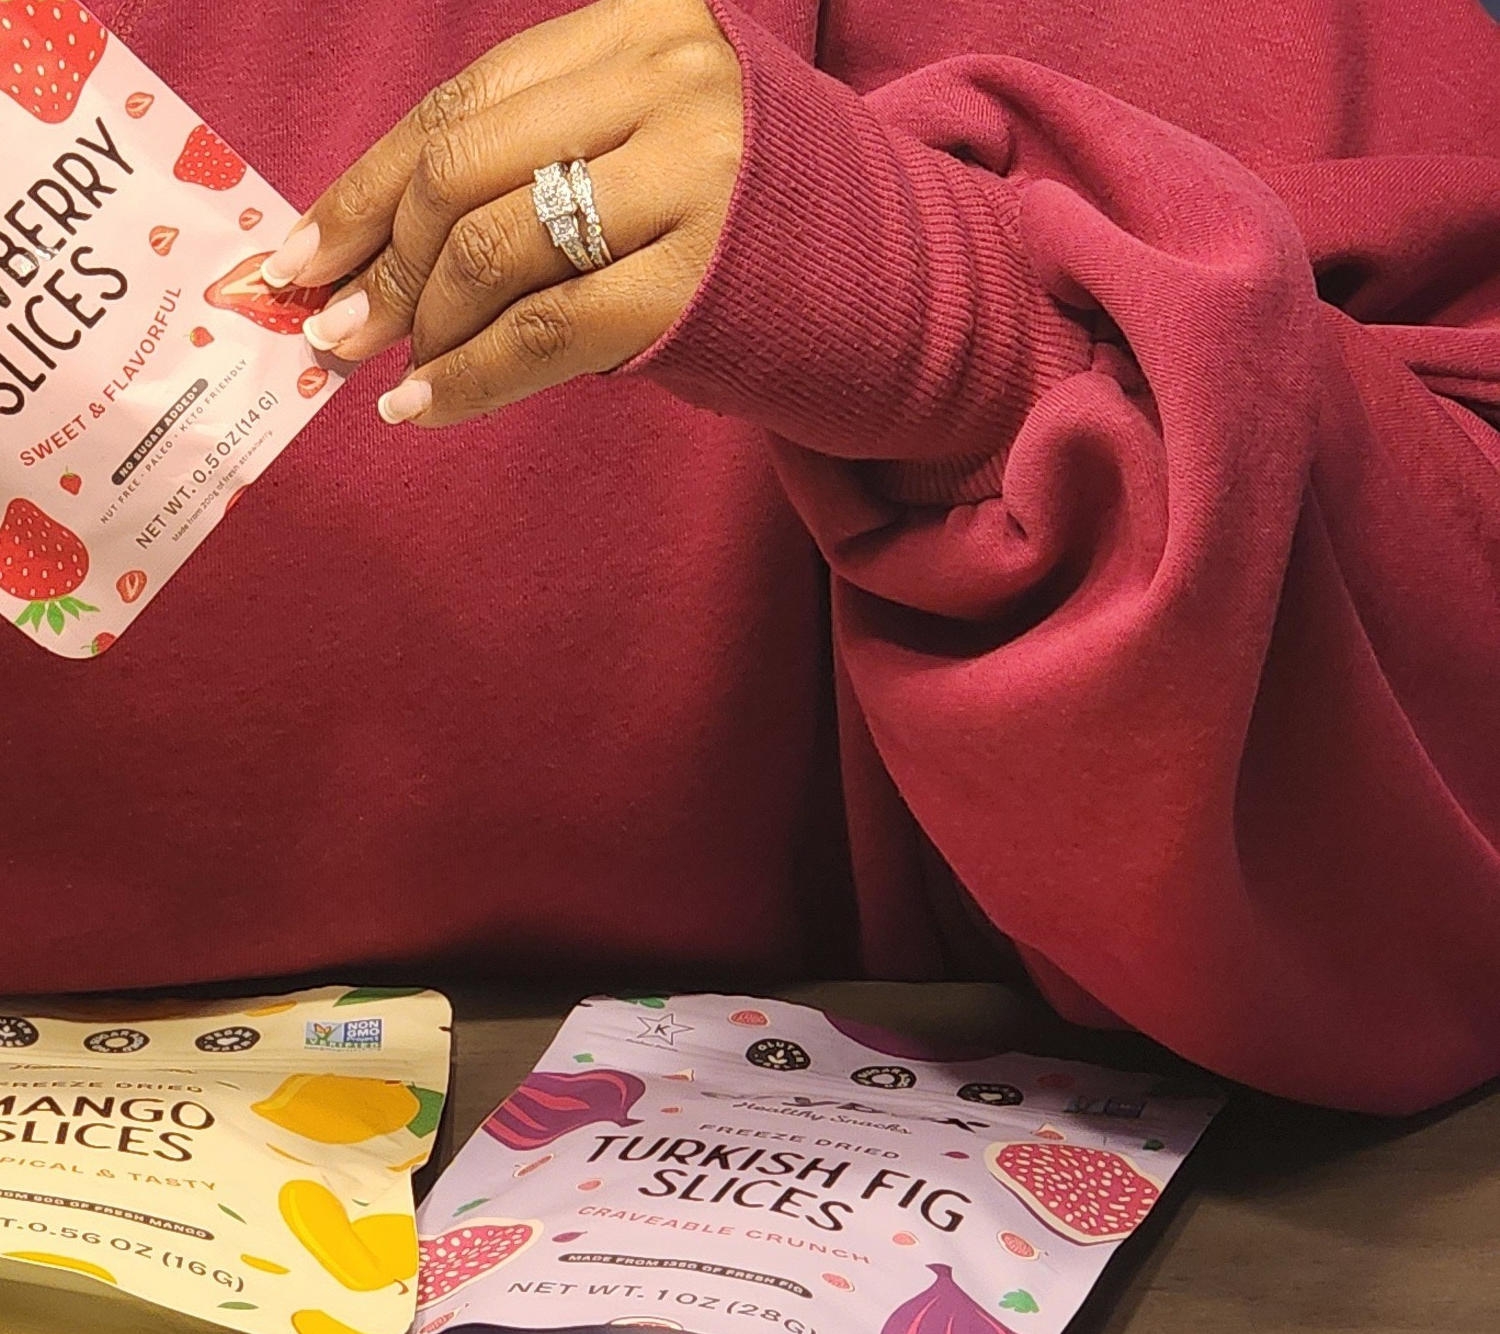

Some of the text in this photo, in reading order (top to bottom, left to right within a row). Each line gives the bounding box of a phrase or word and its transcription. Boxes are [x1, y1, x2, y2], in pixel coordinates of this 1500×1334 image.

[20, 287, 181, 467] SWEET & FLAVORFUL
[100, 358, 247, 524] NUT FREE PALEO KETO FRIENDLY
[135, 426, 164, 459] SUGAR
[136, 484, 197, 549] NET WT.
[116, 1082, 203, 1093] DRIED
[732, 1101, 825, 1121] Healthy
[828, 1113, 913, 1135] Snacks
[699, 1124, 900, 1159] FREEZE DRIED
[128, 1172, 217, 1192] TASTY
[587, 1136, 972, 1233] TURKISH FIG
[638, 1169, 854, 1232] SLICES
[148, 1217, 207, 1238] MANGO
[578, 1206, 871, 1265] CRAVEABLE CRUNCH
[507, 1281, 646, 1299] NET WT.
